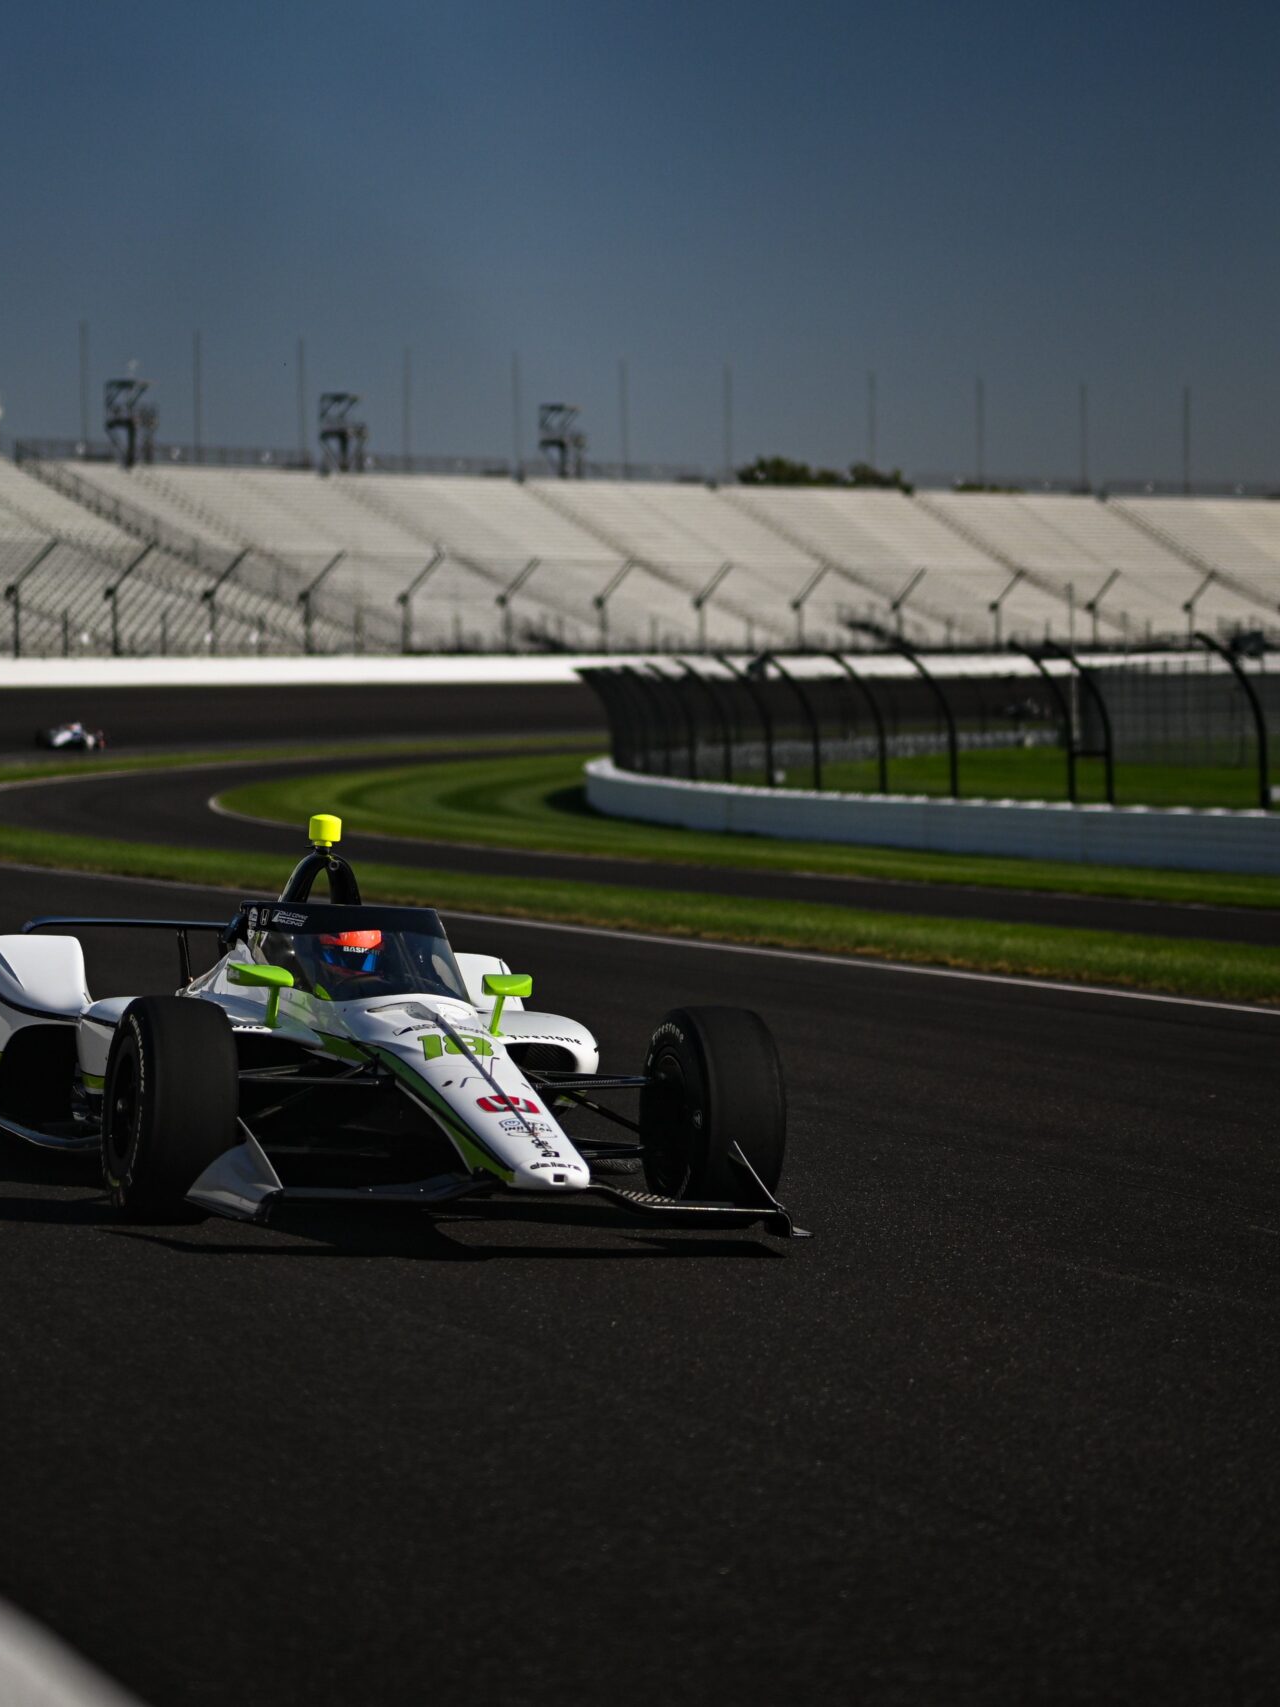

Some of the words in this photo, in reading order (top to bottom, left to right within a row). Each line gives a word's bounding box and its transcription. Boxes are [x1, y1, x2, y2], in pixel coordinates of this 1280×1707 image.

[651, 1022, 684, 1046] Firestone
[417, 1033, 495, 1061] 18
[529, 1161, 583, 1173] dallara
